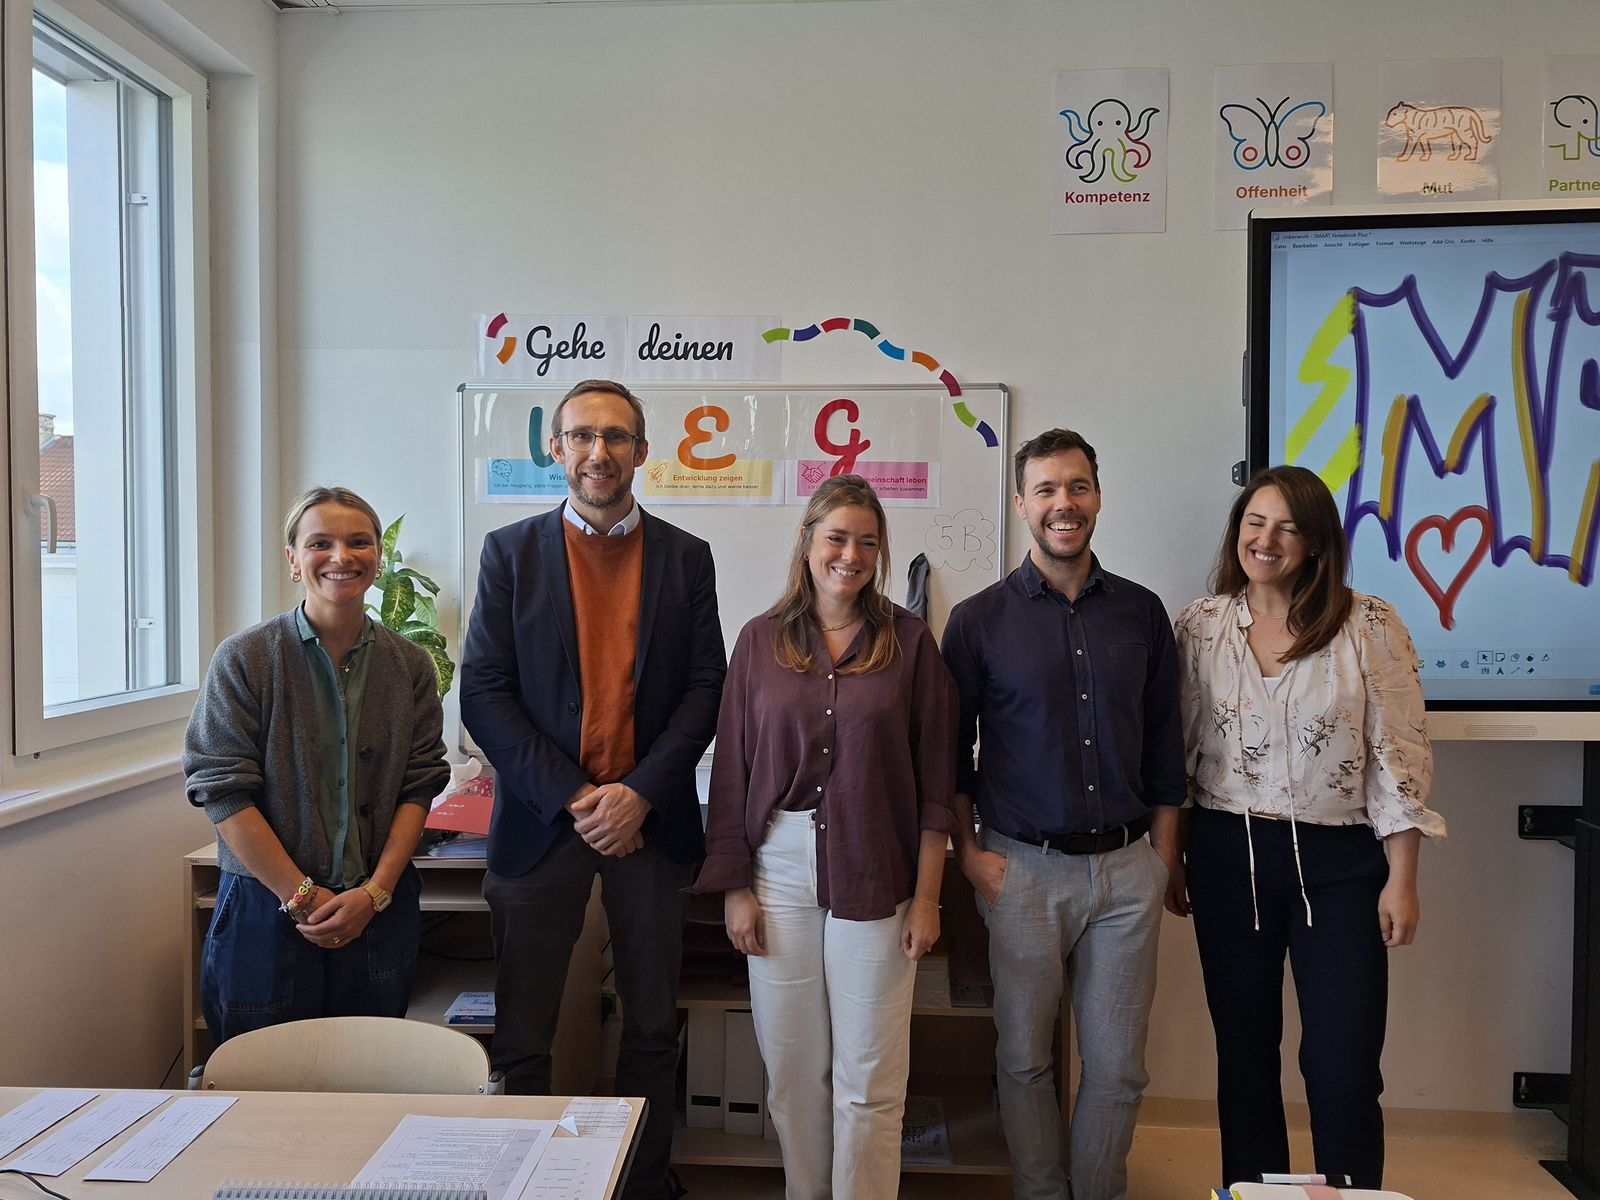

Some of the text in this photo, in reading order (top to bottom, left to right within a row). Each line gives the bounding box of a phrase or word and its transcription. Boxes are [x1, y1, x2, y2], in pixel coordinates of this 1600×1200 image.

[1236, 184, 1308, 198] Offenheit
[1423, 181, 1453, 194] Mut
[1065, 191, 1151, 205] Kompetenz
[526, 321, 734, 377] Gehe deinen
[677, 405, 737, 471] E
[673, 474, 718, 482] Entwicklung
[864, 476, 927, 484] meinschaft leben
